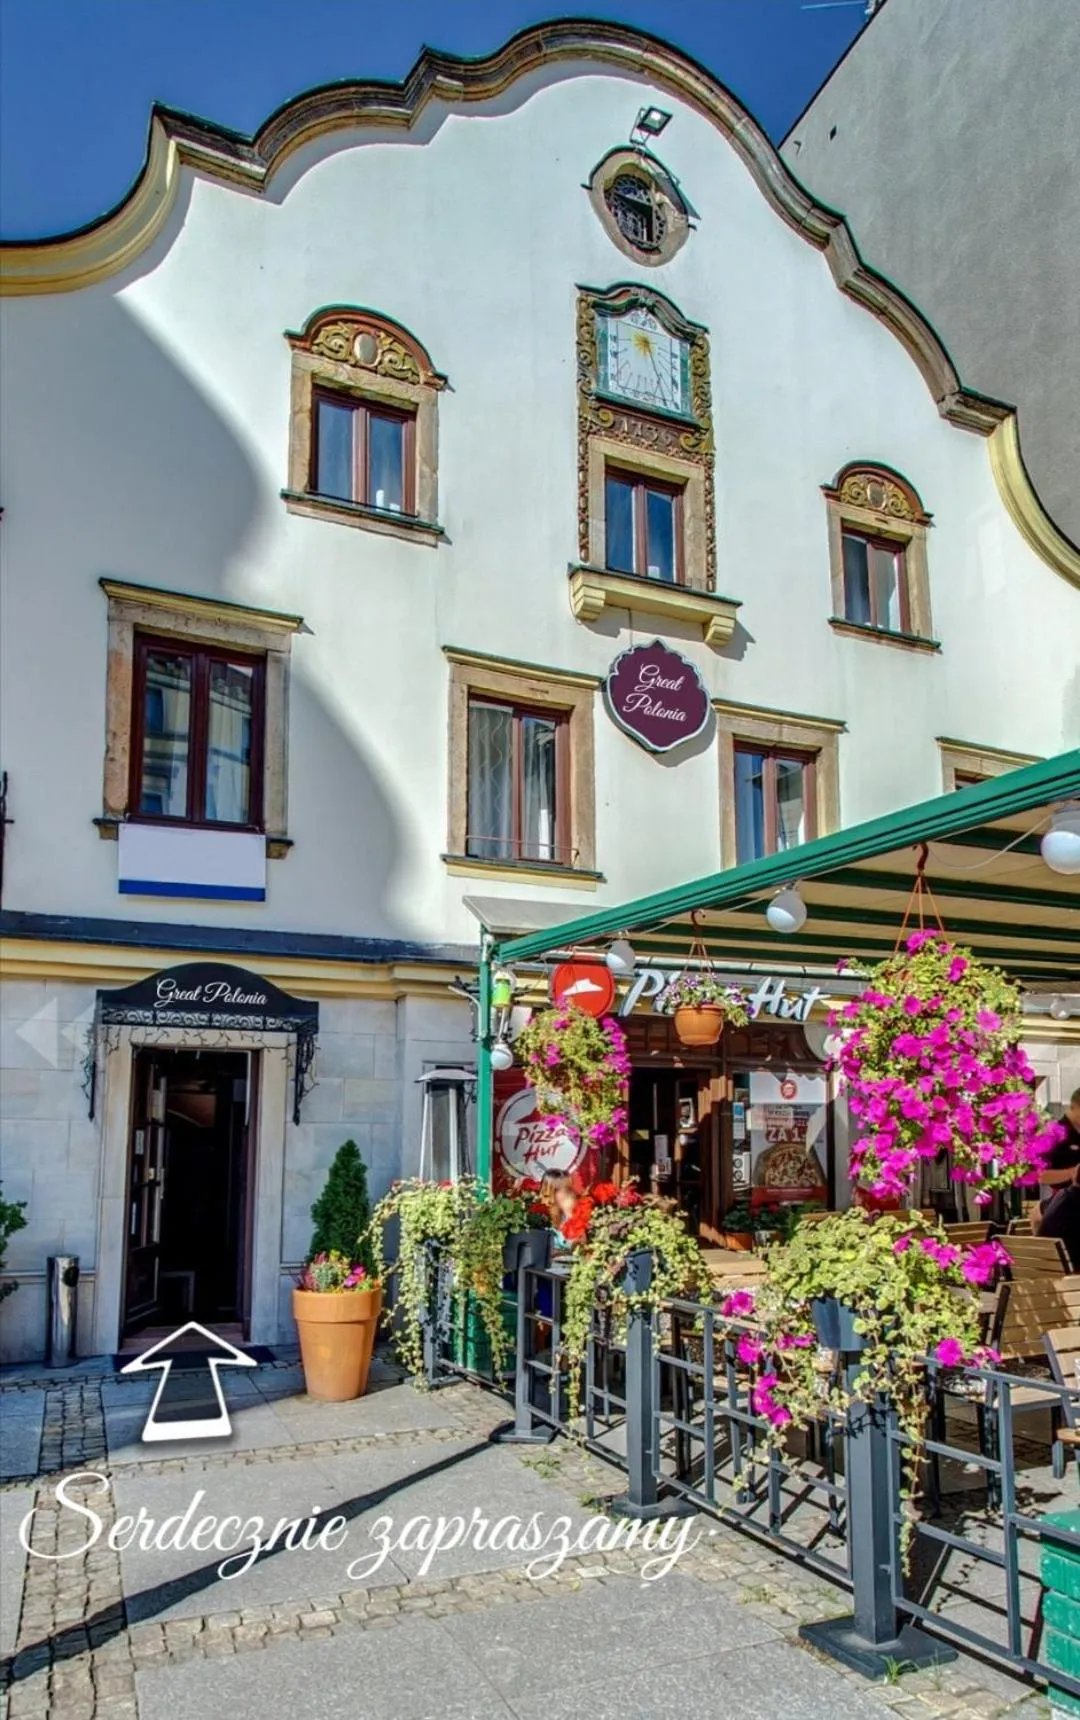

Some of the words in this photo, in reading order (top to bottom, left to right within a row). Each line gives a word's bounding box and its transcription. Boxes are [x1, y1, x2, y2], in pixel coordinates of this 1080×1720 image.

[634, 663, 685, 692] Great
[622, 692, 687, 722] Polonia
[153, 978, 203, 1008] Great
[202, 981, 268, 1005] Polonia
[747, 976, 831, 1021] Hut
[513, 1124, 566, 1151] Pizza
[522, 1141, 565, 1165] Hut
